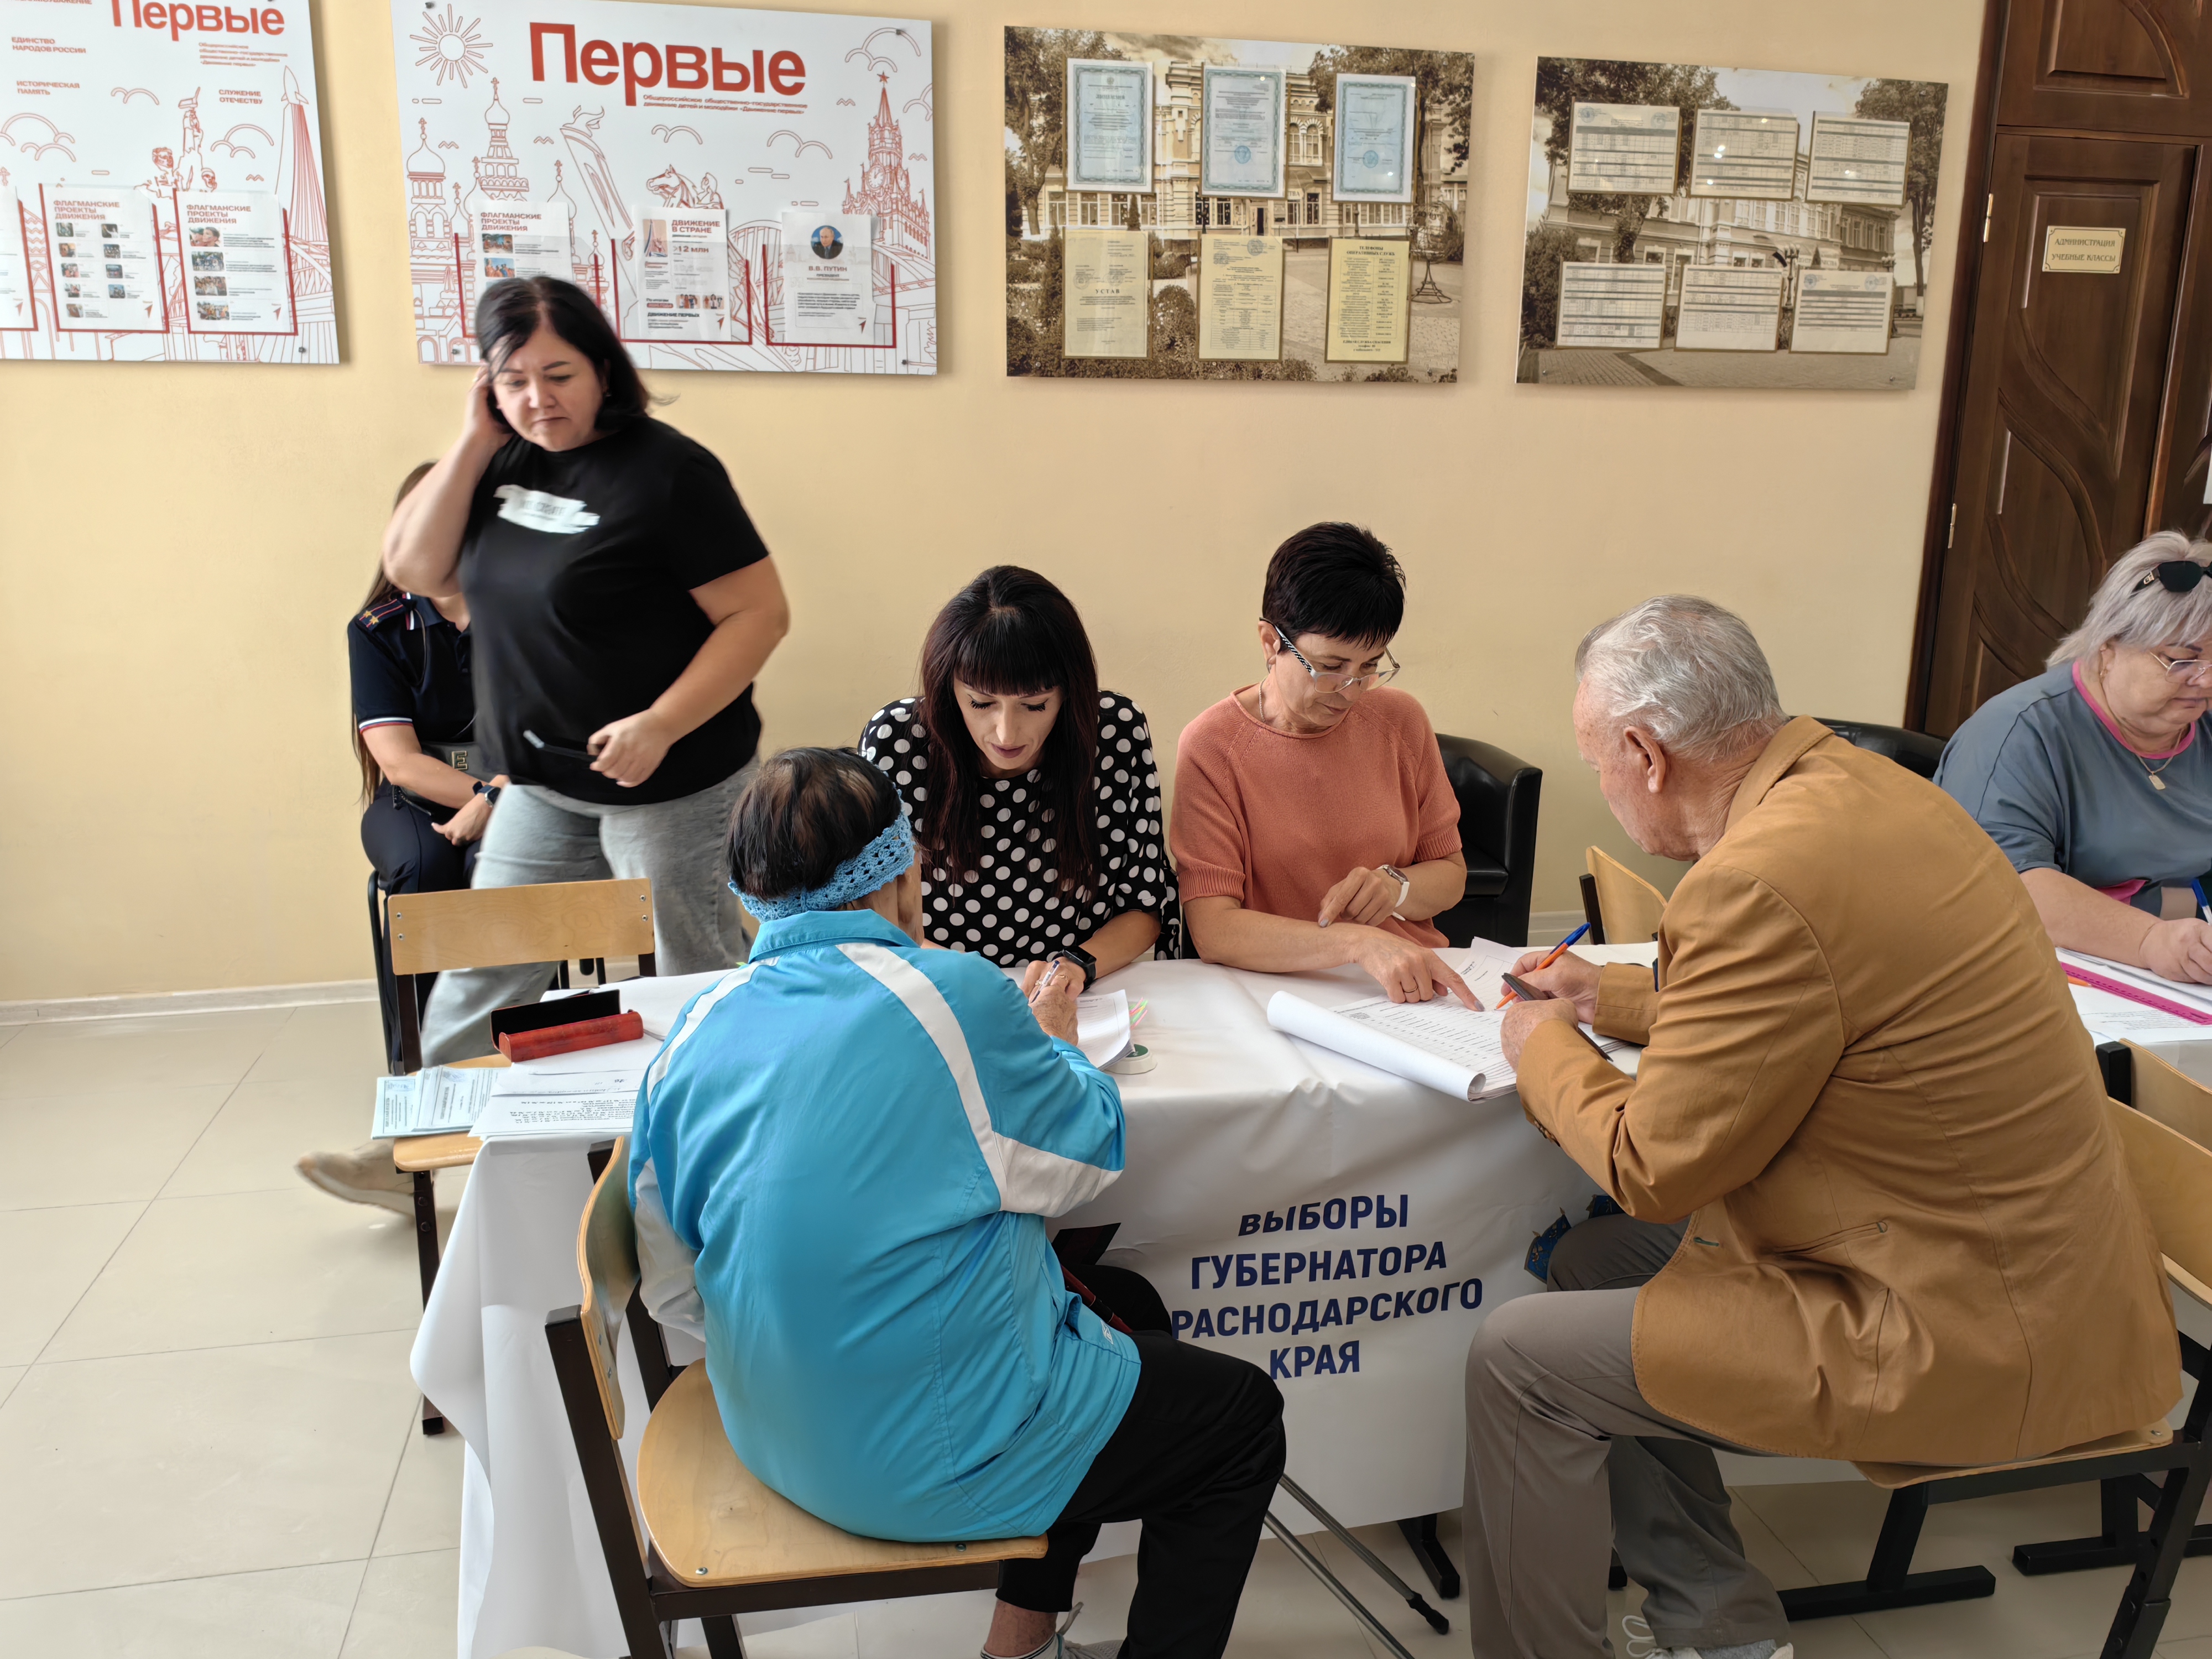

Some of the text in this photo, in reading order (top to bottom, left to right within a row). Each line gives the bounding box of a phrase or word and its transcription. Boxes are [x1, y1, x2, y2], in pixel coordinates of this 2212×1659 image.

[17, 80, 80, 88] ИСТОРИЧЕСКАЯ
[529, 22, 806, 106] Первые
[2054, 238, 2116, 247] АДМИНИСТРАЦИЯ
[1238, 1194, 1408, 1237] ВЫБОРЫ
[1191, 1241, 1447, 1290] ГУБЕРНАТОРА
[1171, 1278, 1483, 1340] РАСНОДАРСКОГО
[1270, 1340, 1360, 1380] КРАЯ
